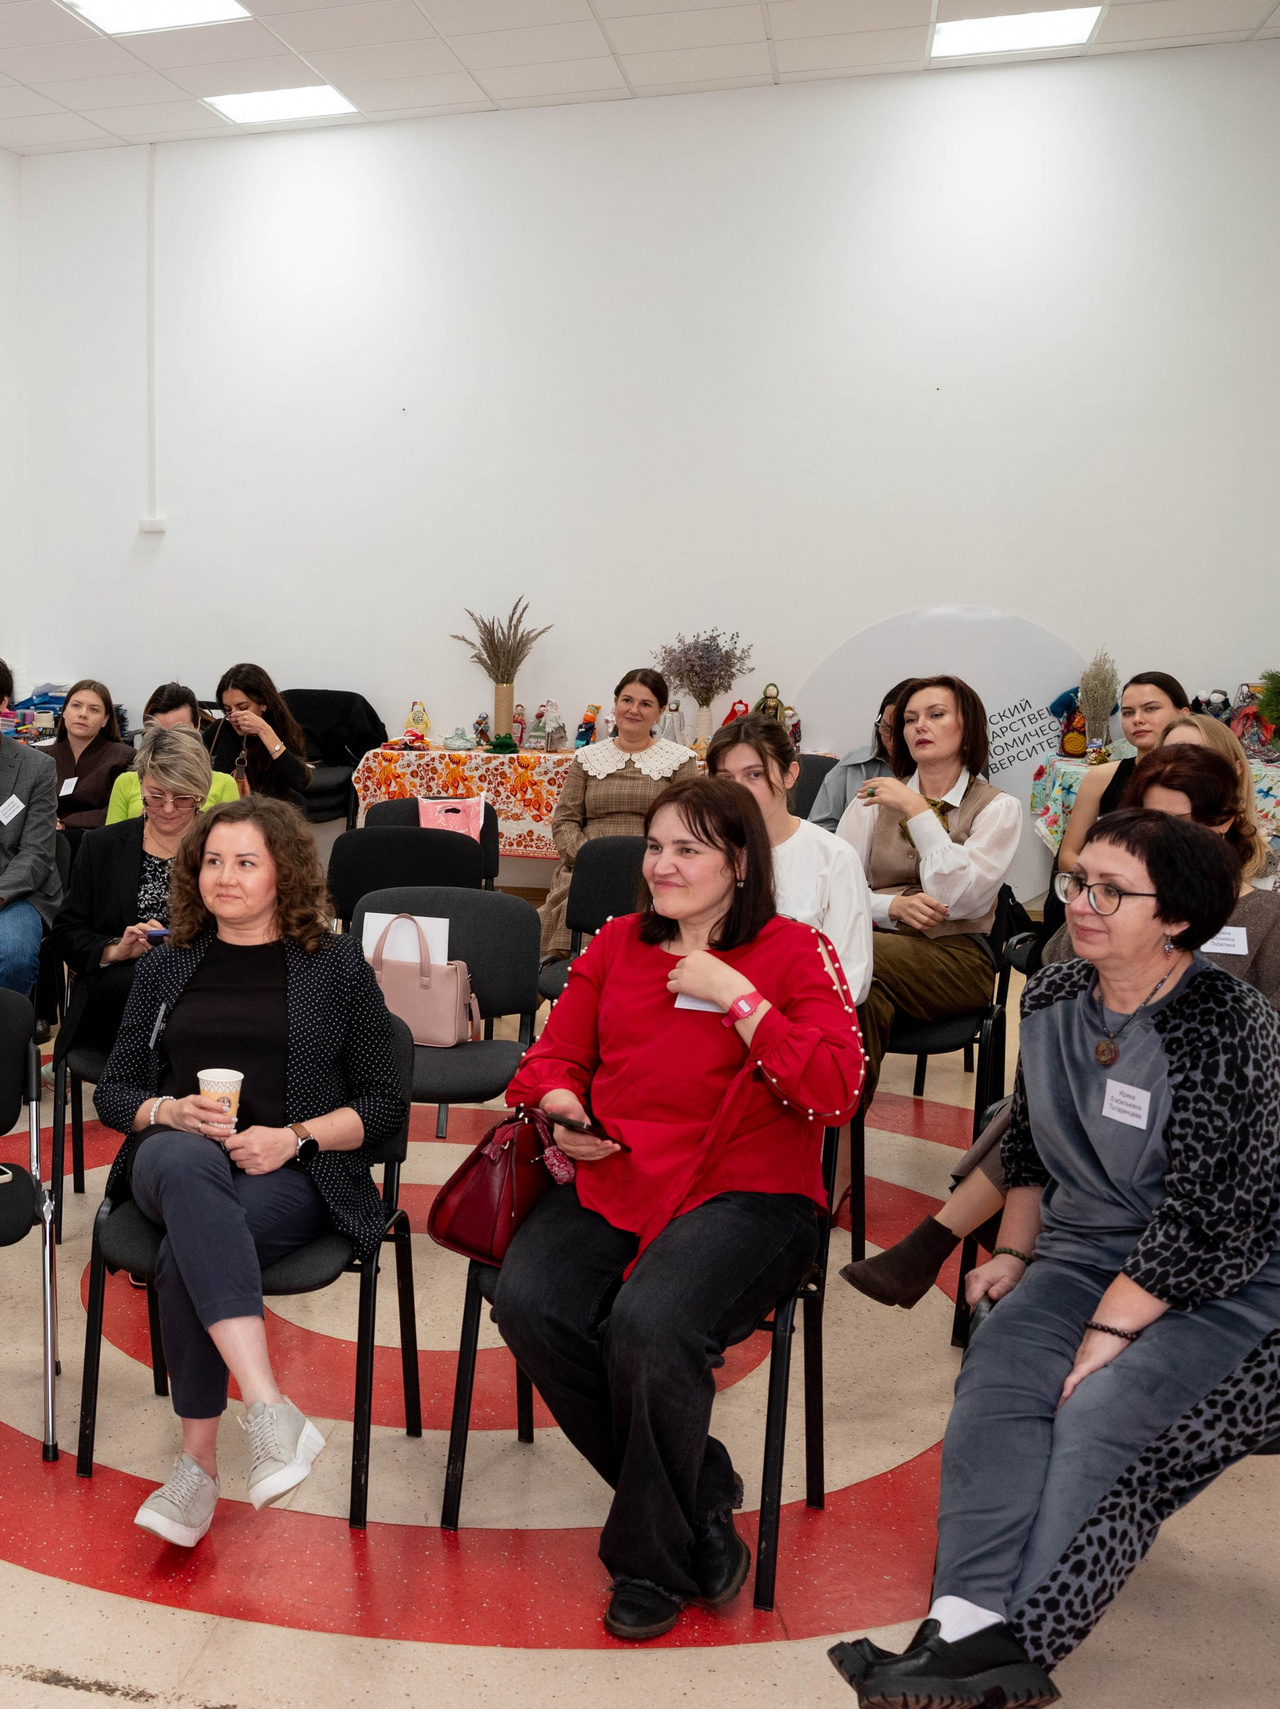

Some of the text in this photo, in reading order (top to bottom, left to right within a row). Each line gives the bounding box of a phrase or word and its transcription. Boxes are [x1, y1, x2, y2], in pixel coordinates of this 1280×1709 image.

[988, 698, 1032, 726] СКИЙ
[989, 706, 1051, 745] АРСТВЕ
[988, 734, 1061, 774] ВЕРСИТЕ
